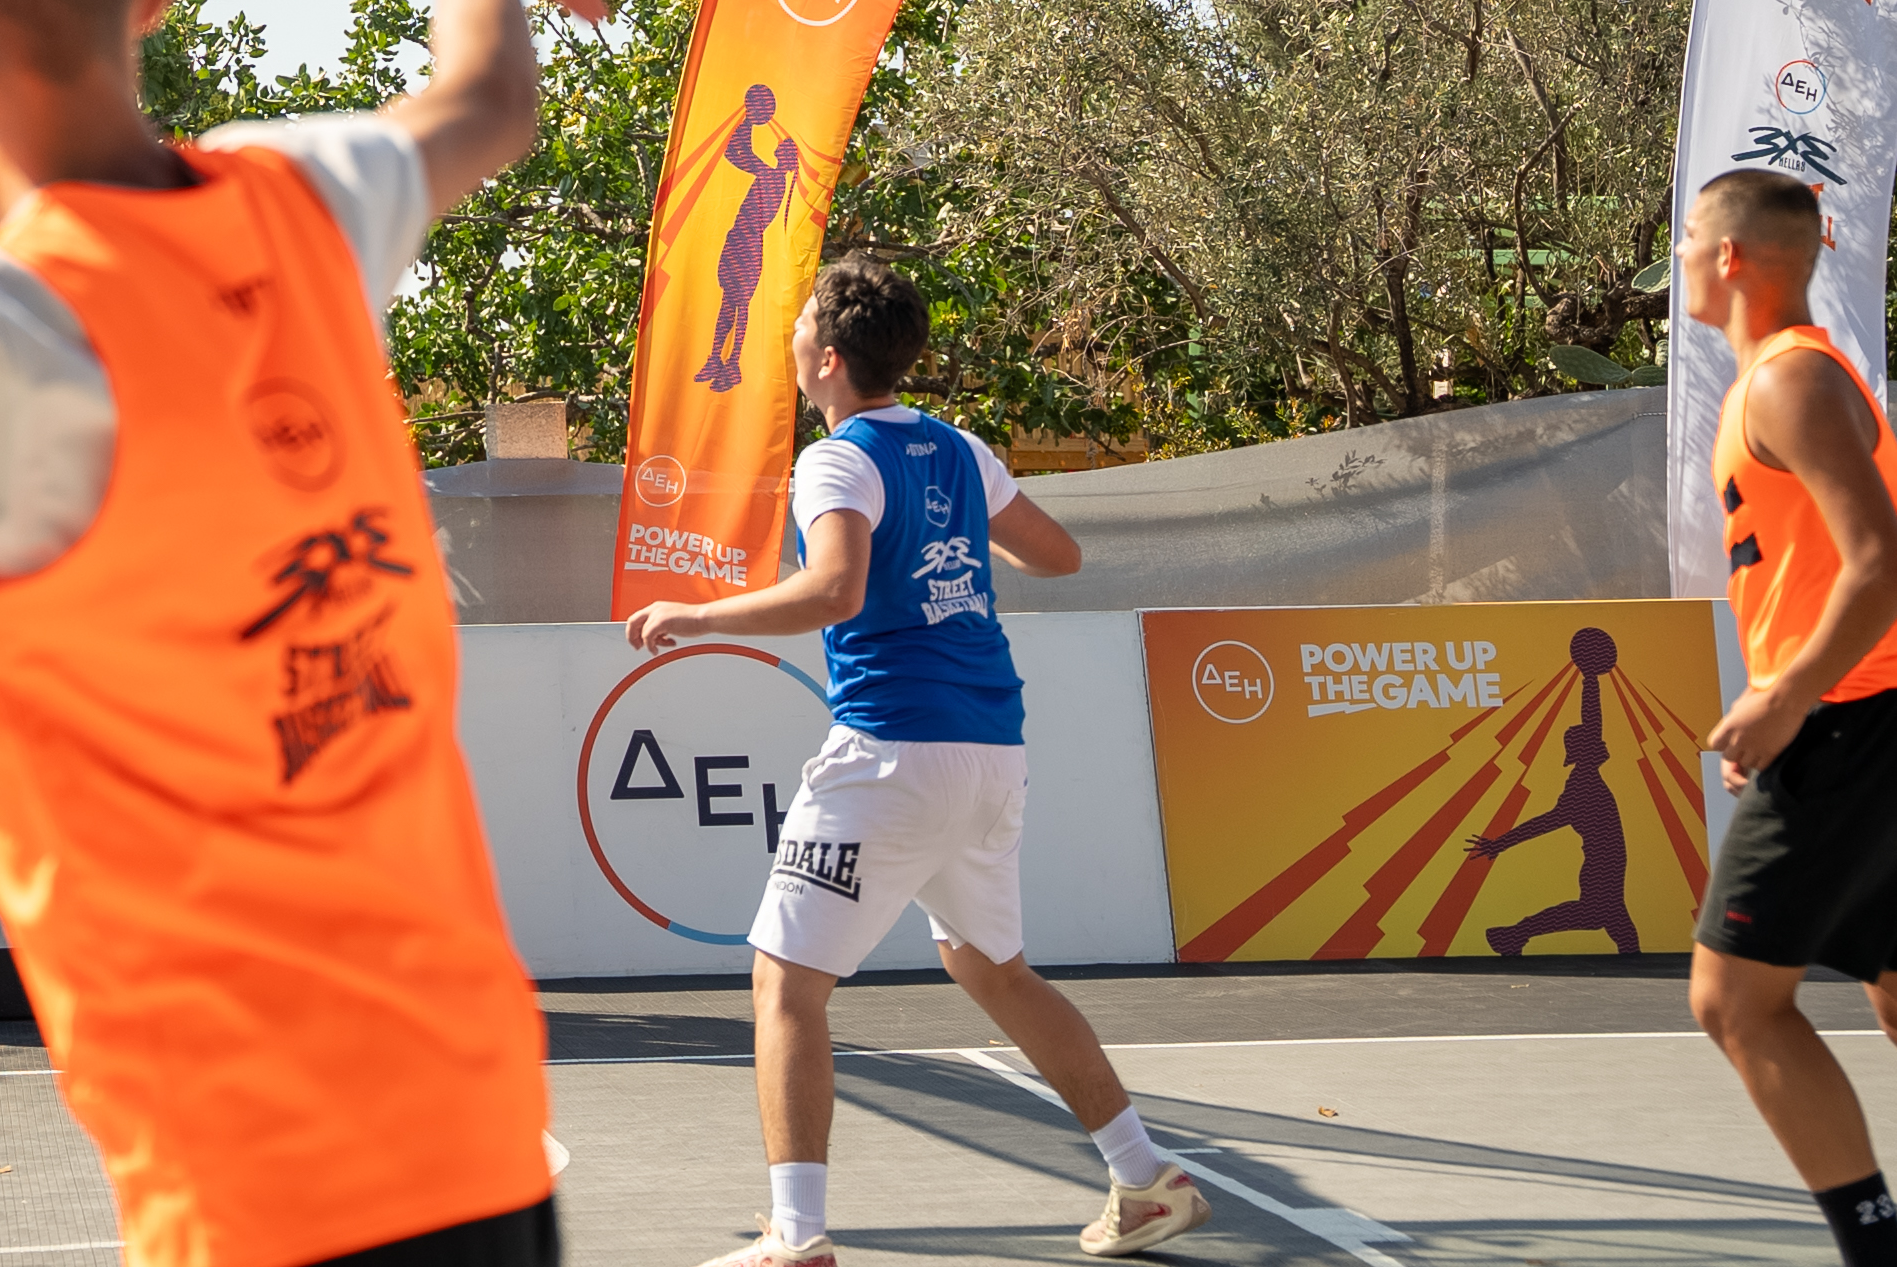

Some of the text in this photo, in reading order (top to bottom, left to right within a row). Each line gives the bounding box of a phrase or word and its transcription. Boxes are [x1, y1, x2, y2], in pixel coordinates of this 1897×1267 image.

[1781, 72, 1817, 102] ΔΕΗ
[641, 467, 679, 494] ΔΕΗ
[629, 523, 747, 565] POWER UP
[628, 544, 747, 588] THE GAME
[928, 569, 975, 601] STREET
[1300, 641, 1497, 672] POWER UP
[1201, 663, 1263, 699] ΔΕΗ
[1304, 673, 1503, 709] THE GAME
